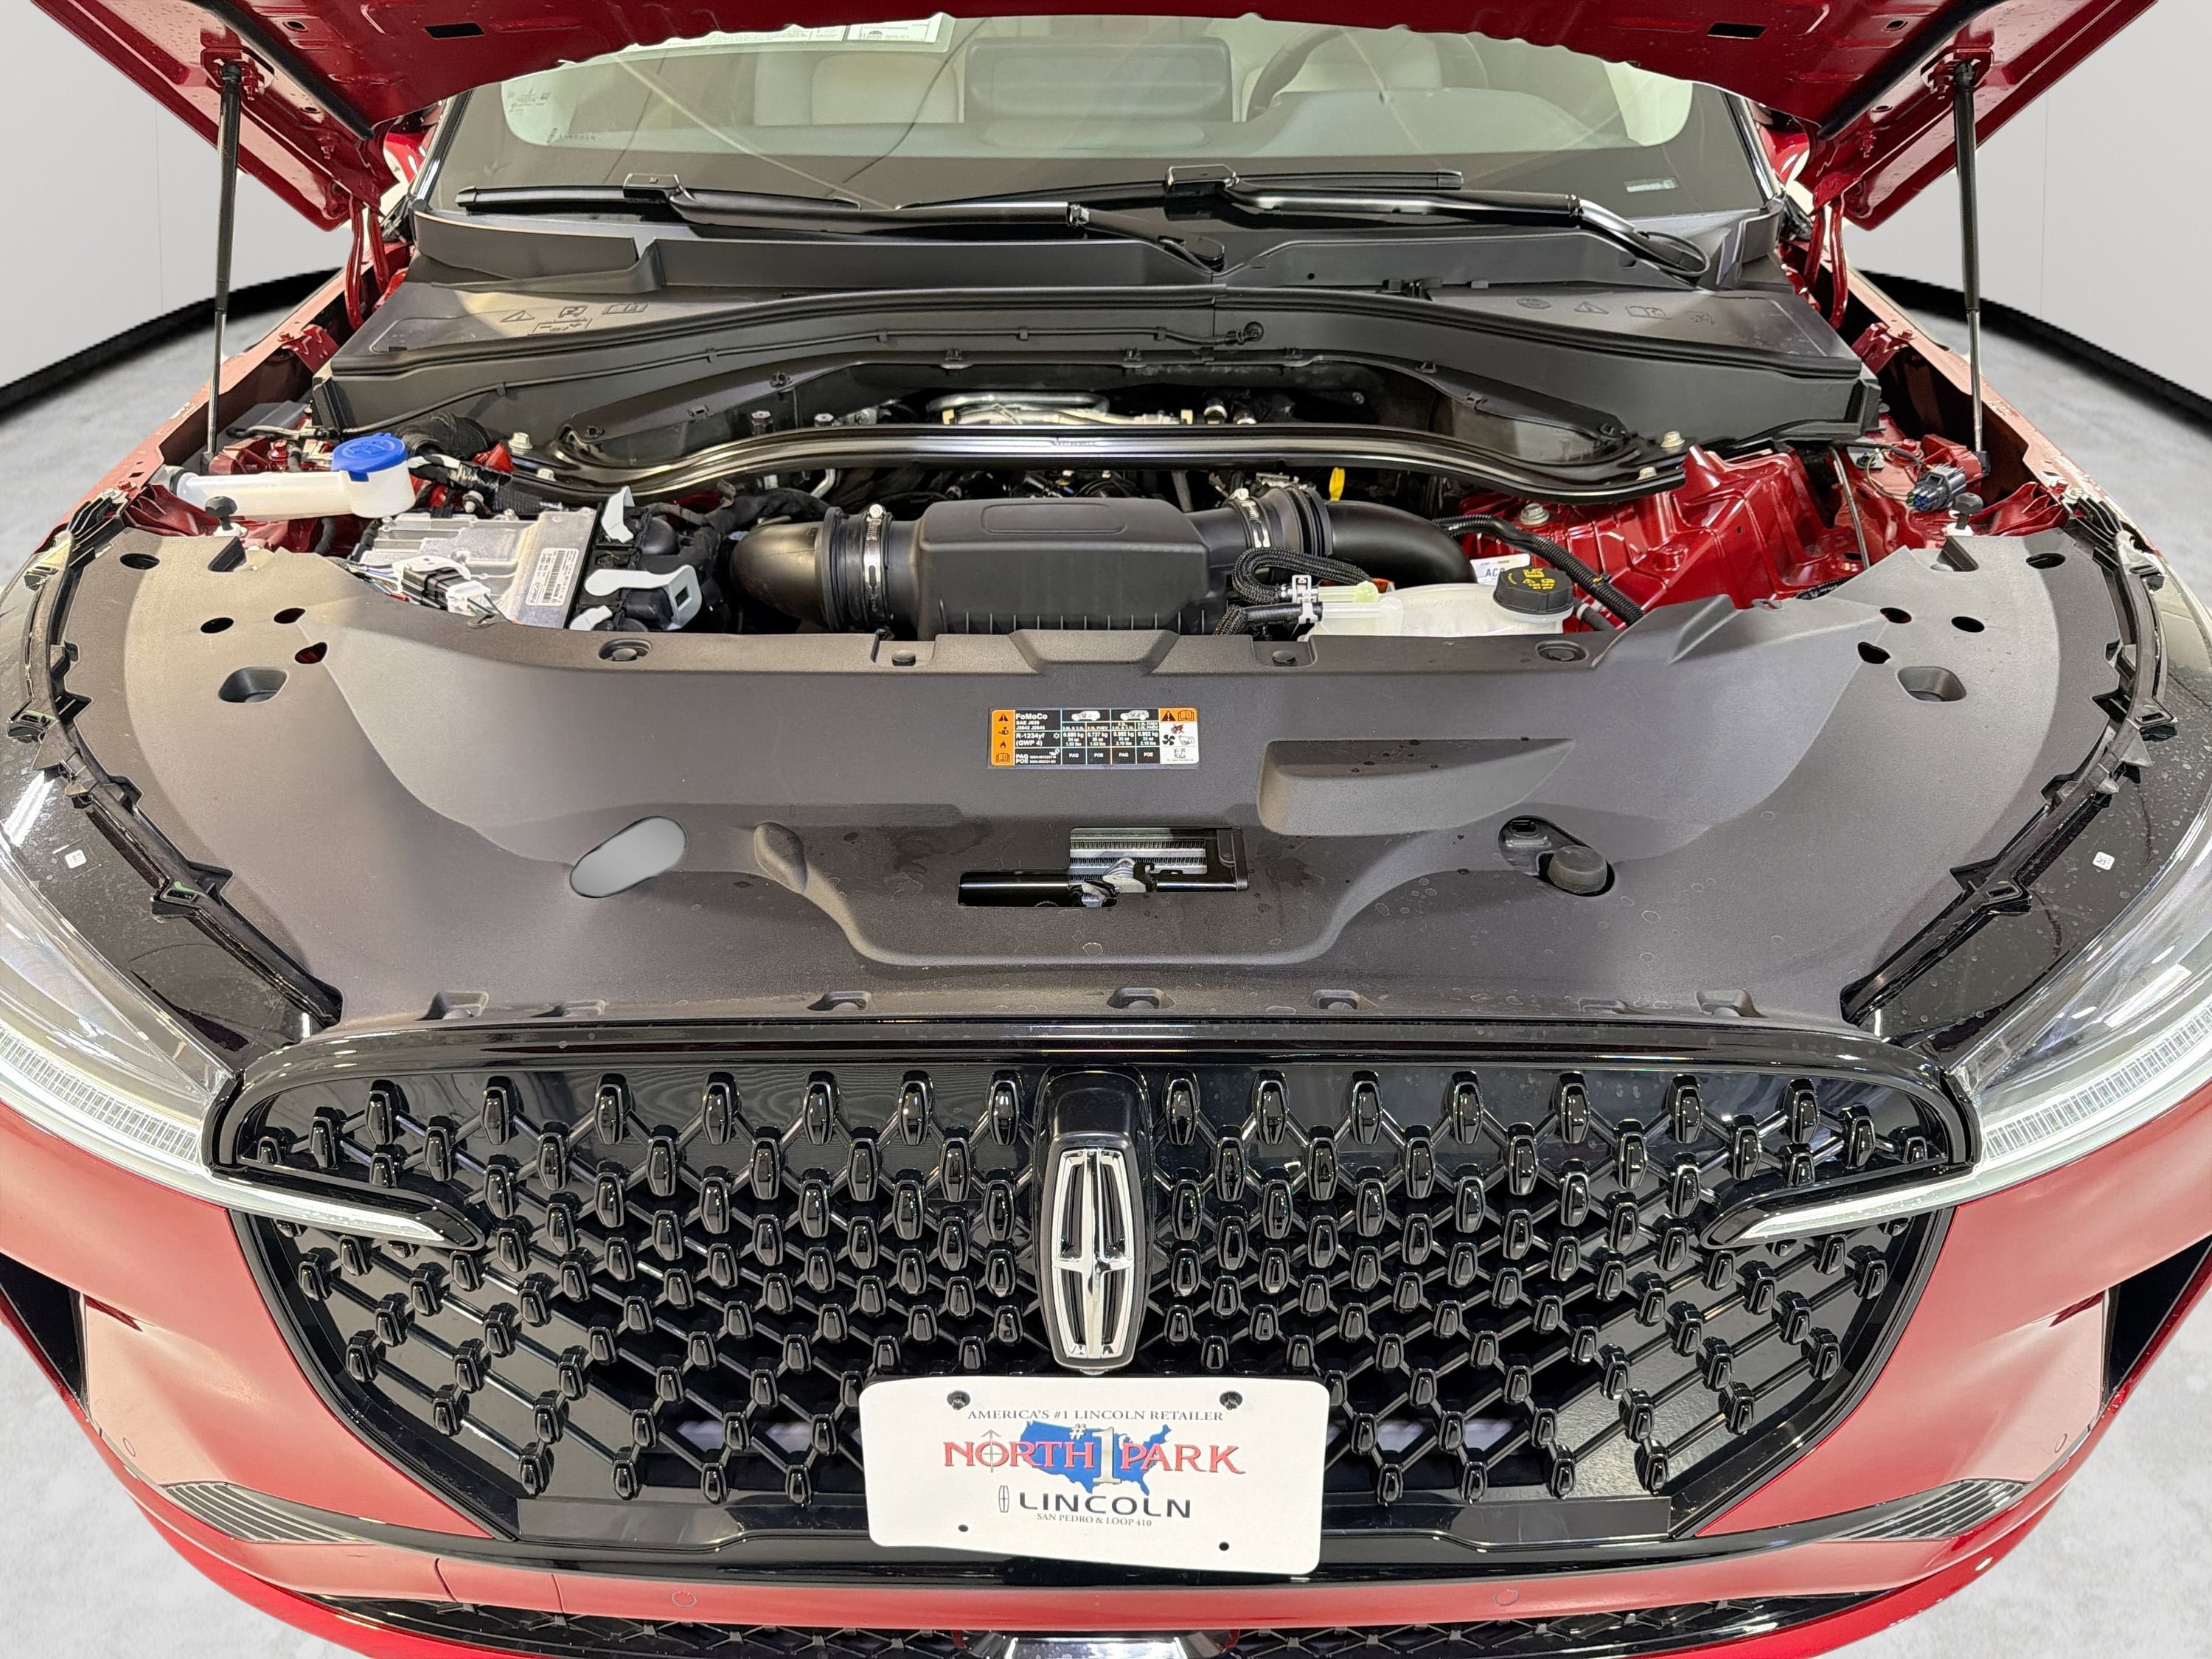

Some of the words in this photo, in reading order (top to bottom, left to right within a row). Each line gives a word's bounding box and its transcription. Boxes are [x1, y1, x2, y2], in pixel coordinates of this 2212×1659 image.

[967, 1409, 1050, 1420] AMERICA'S
[1054, 1410, 1068, 1419] #1
[1074, 1410, 1145, 1420] LINCOLN
[1150, 1410, 1224, 1421] RETAILER
[943, 1441, 1096, 1470] NORTH
[1119, 1442, 1247, 1475] PARK
[1019, 1492, 1191, 1519] LINCOLN
[1036, 1512, 1057, 1521] SAN
[1059, 1514, 1093, 1524] PEDRO
[1105, 1517, 1134, 1526] LOOP
[1135, 1518, 1152, 1526] 410
